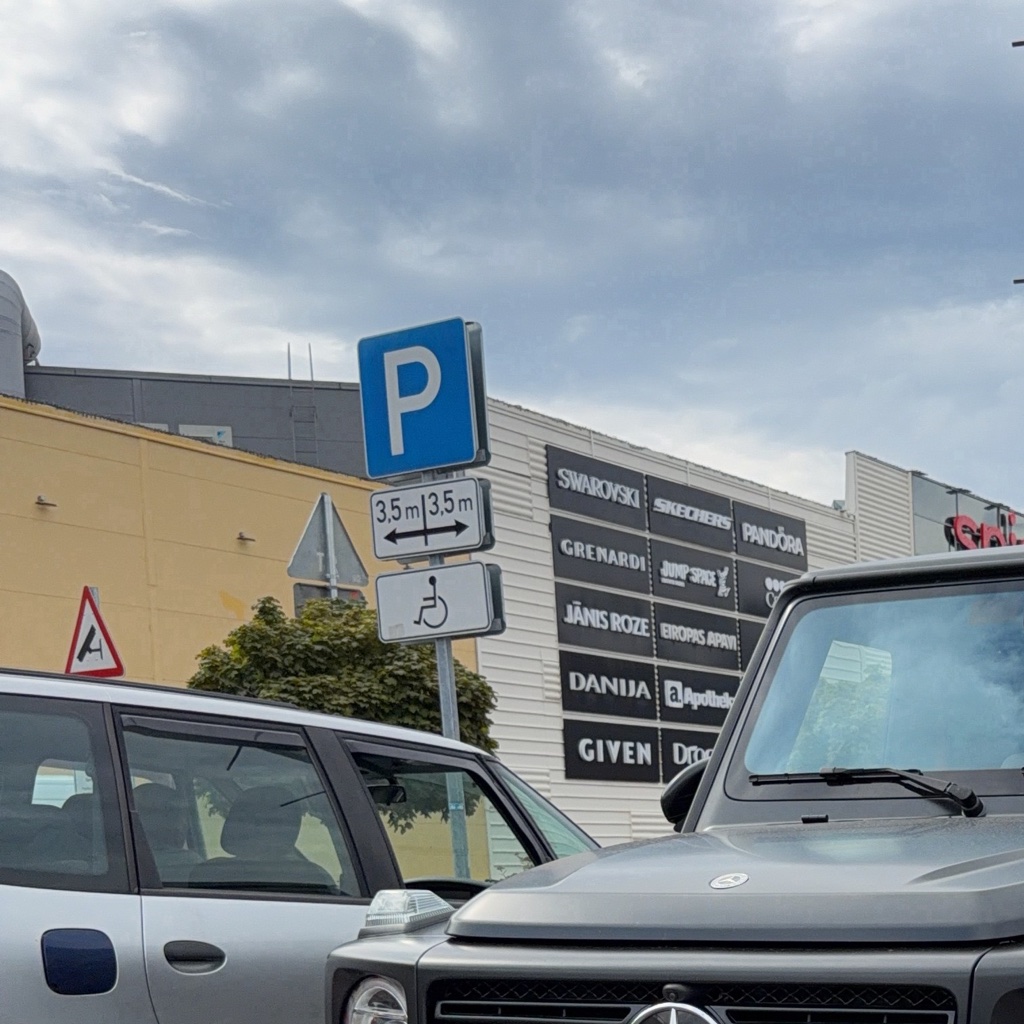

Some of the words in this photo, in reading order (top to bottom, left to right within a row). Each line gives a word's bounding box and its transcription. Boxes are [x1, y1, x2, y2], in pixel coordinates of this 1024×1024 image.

[383, 345, 442, 456] P
[428, 489, 455, 516] 3,5
[458, 497, 473, 512] m
[557, 468, 640, 508] SWAROVSKI
[375, 497, 402, 524] 3,5
[405, 505, 420, 520] m
[652, 498, 732, 530] SKECHERS
[560, 539, 645, 571] GRENARDI
[660, 560, 690, 580] JUMP
[564, 600, 609, 630] JĀNIS
[609, 611, 651, 637] ROZE
[660, 622, 706, 646] EIROPAS
[706, 630, 738, 651] APAVI
[568, 671, 652, 700] DANIJA
[683, 686, 736, 711] Apothek
[578, 737, 653, 766] GIVEN
